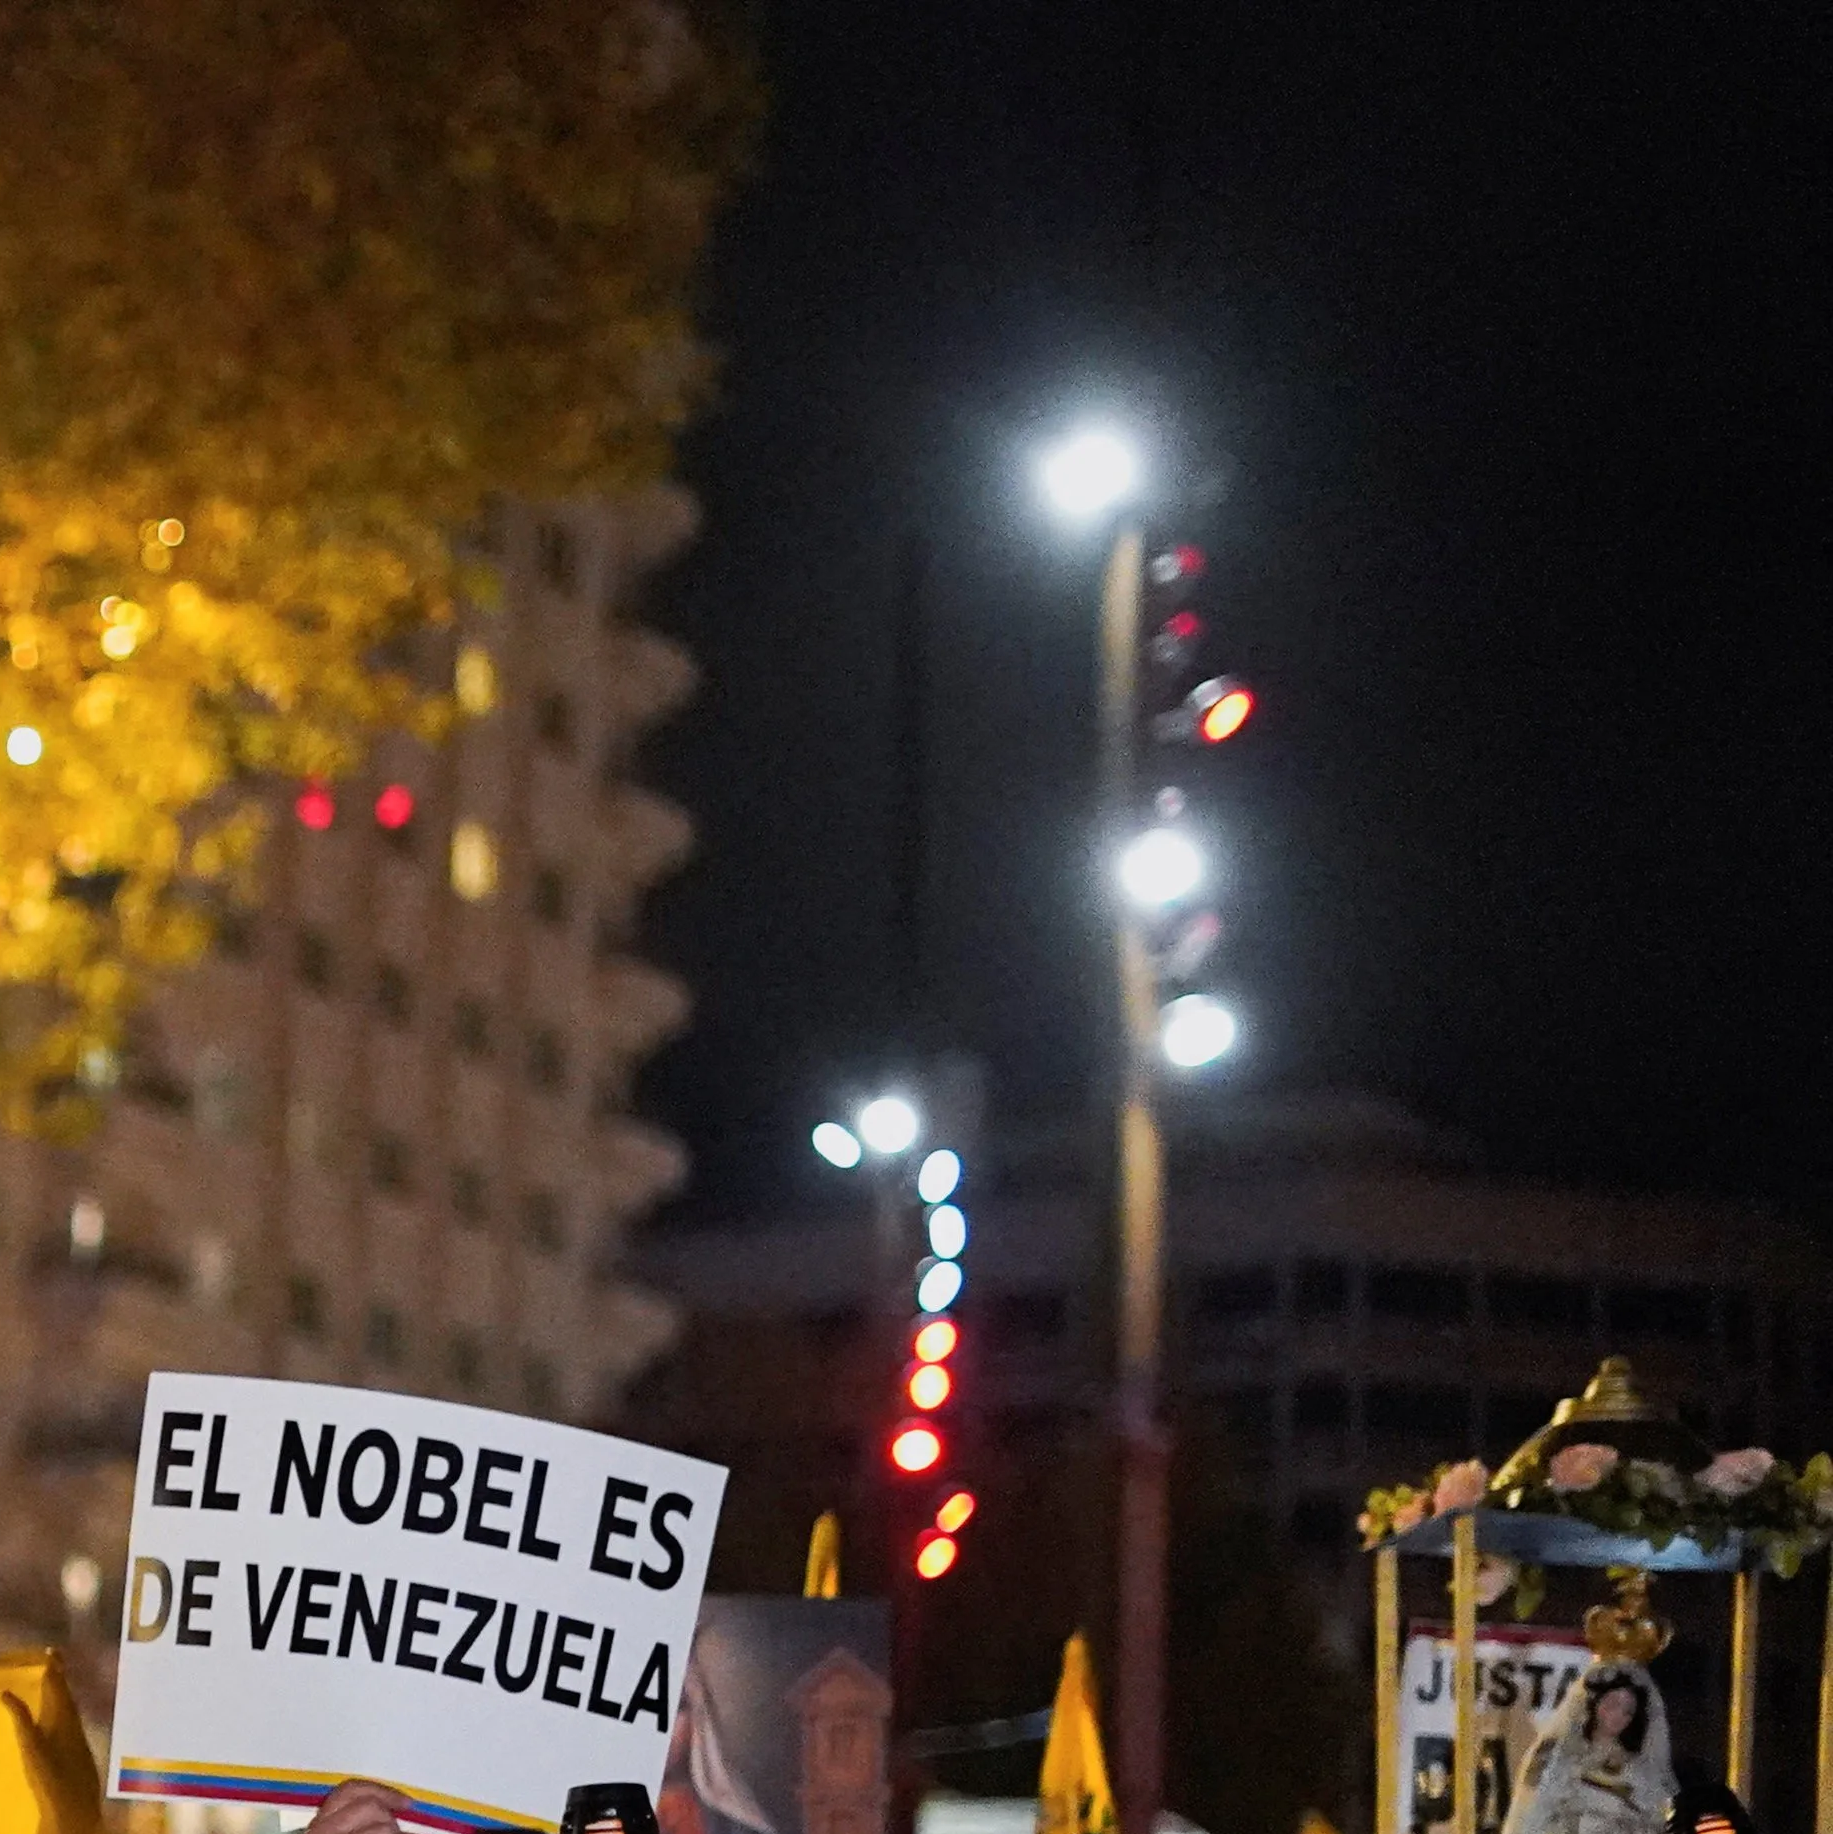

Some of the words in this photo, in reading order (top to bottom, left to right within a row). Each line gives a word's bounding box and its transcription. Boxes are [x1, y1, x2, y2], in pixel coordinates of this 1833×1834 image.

[152, 1410, 241, 1512] EL
[270, 1419, 562, 1562] NOBEL
[589, 1476, 694, 1592] ES
[127, 1556, 220, 1647] DE
[246, 1563, 671, 1734] VENEZUELA
